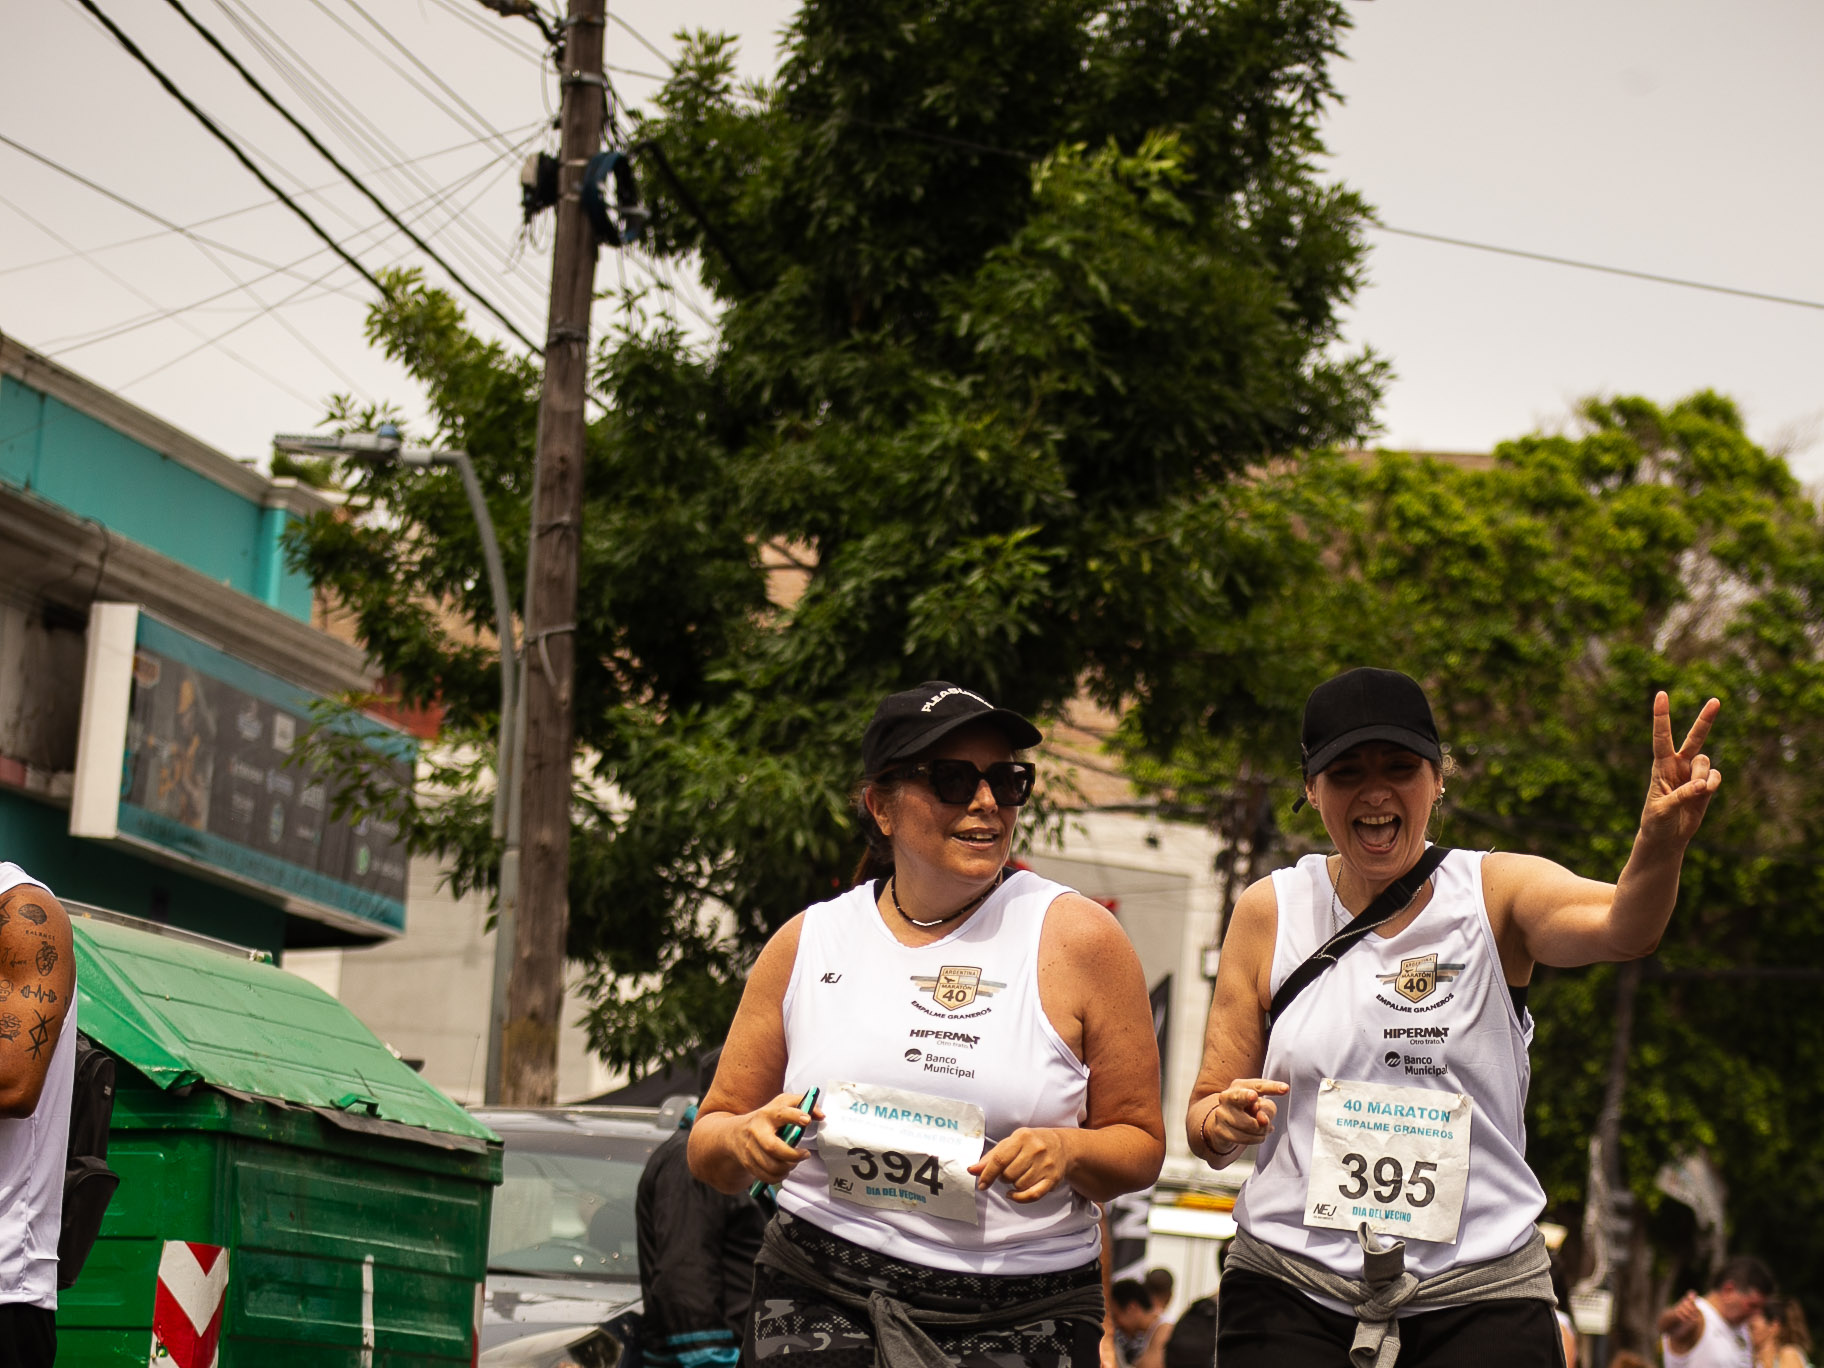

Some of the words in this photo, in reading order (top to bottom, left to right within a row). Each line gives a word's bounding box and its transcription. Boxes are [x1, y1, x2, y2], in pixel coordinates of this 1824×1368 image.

[820, 972, 842, 984] NEJ
[1403, 979, 1428, 993] 40
[942, 989, 967, 1003] 40
[1375, 994, 1412, 1013] EMPALME
[1413, 992, 1454, 1013] GRANEROS
[910, 1000, 946, 1019] EMPALME
[947, 1007, 992, 1020] GRANEROS
[925, 1053, 957, 1065] Banco
[1403, 1055, 1433, 1065] Banco
[924, 1063, 975, 1080] Municipal
[1404, 1064, 1448, 1077] Municipal
[849, 1101, 869, 1115] 40
[874, 1105, 959, 1130] MARATON
[1343, 1099, 1362, 1112] 40
[1367, 1101, 1451, 1123] MARATON
[1336, 1117, 1390, 1132] EMPALME
[1393, 1124, 1454, 1140] GRANEROS
[847, 1147, 944, 1196] 394
[833, 1177, 854, 1192] NEJ
[1338, 1152, 1438, 1208] 395
[866, 1186, 882, 1195] DIA
[882, 1187, 898, 1197] DEL
[1313, 1203, 1337, 1217] NEJ
[1352, 1206, 1367, 1217] DIA
[1368, 1208, 1383, 1219] DEL
[1384, 1209, 1412, 1222] VECINO
